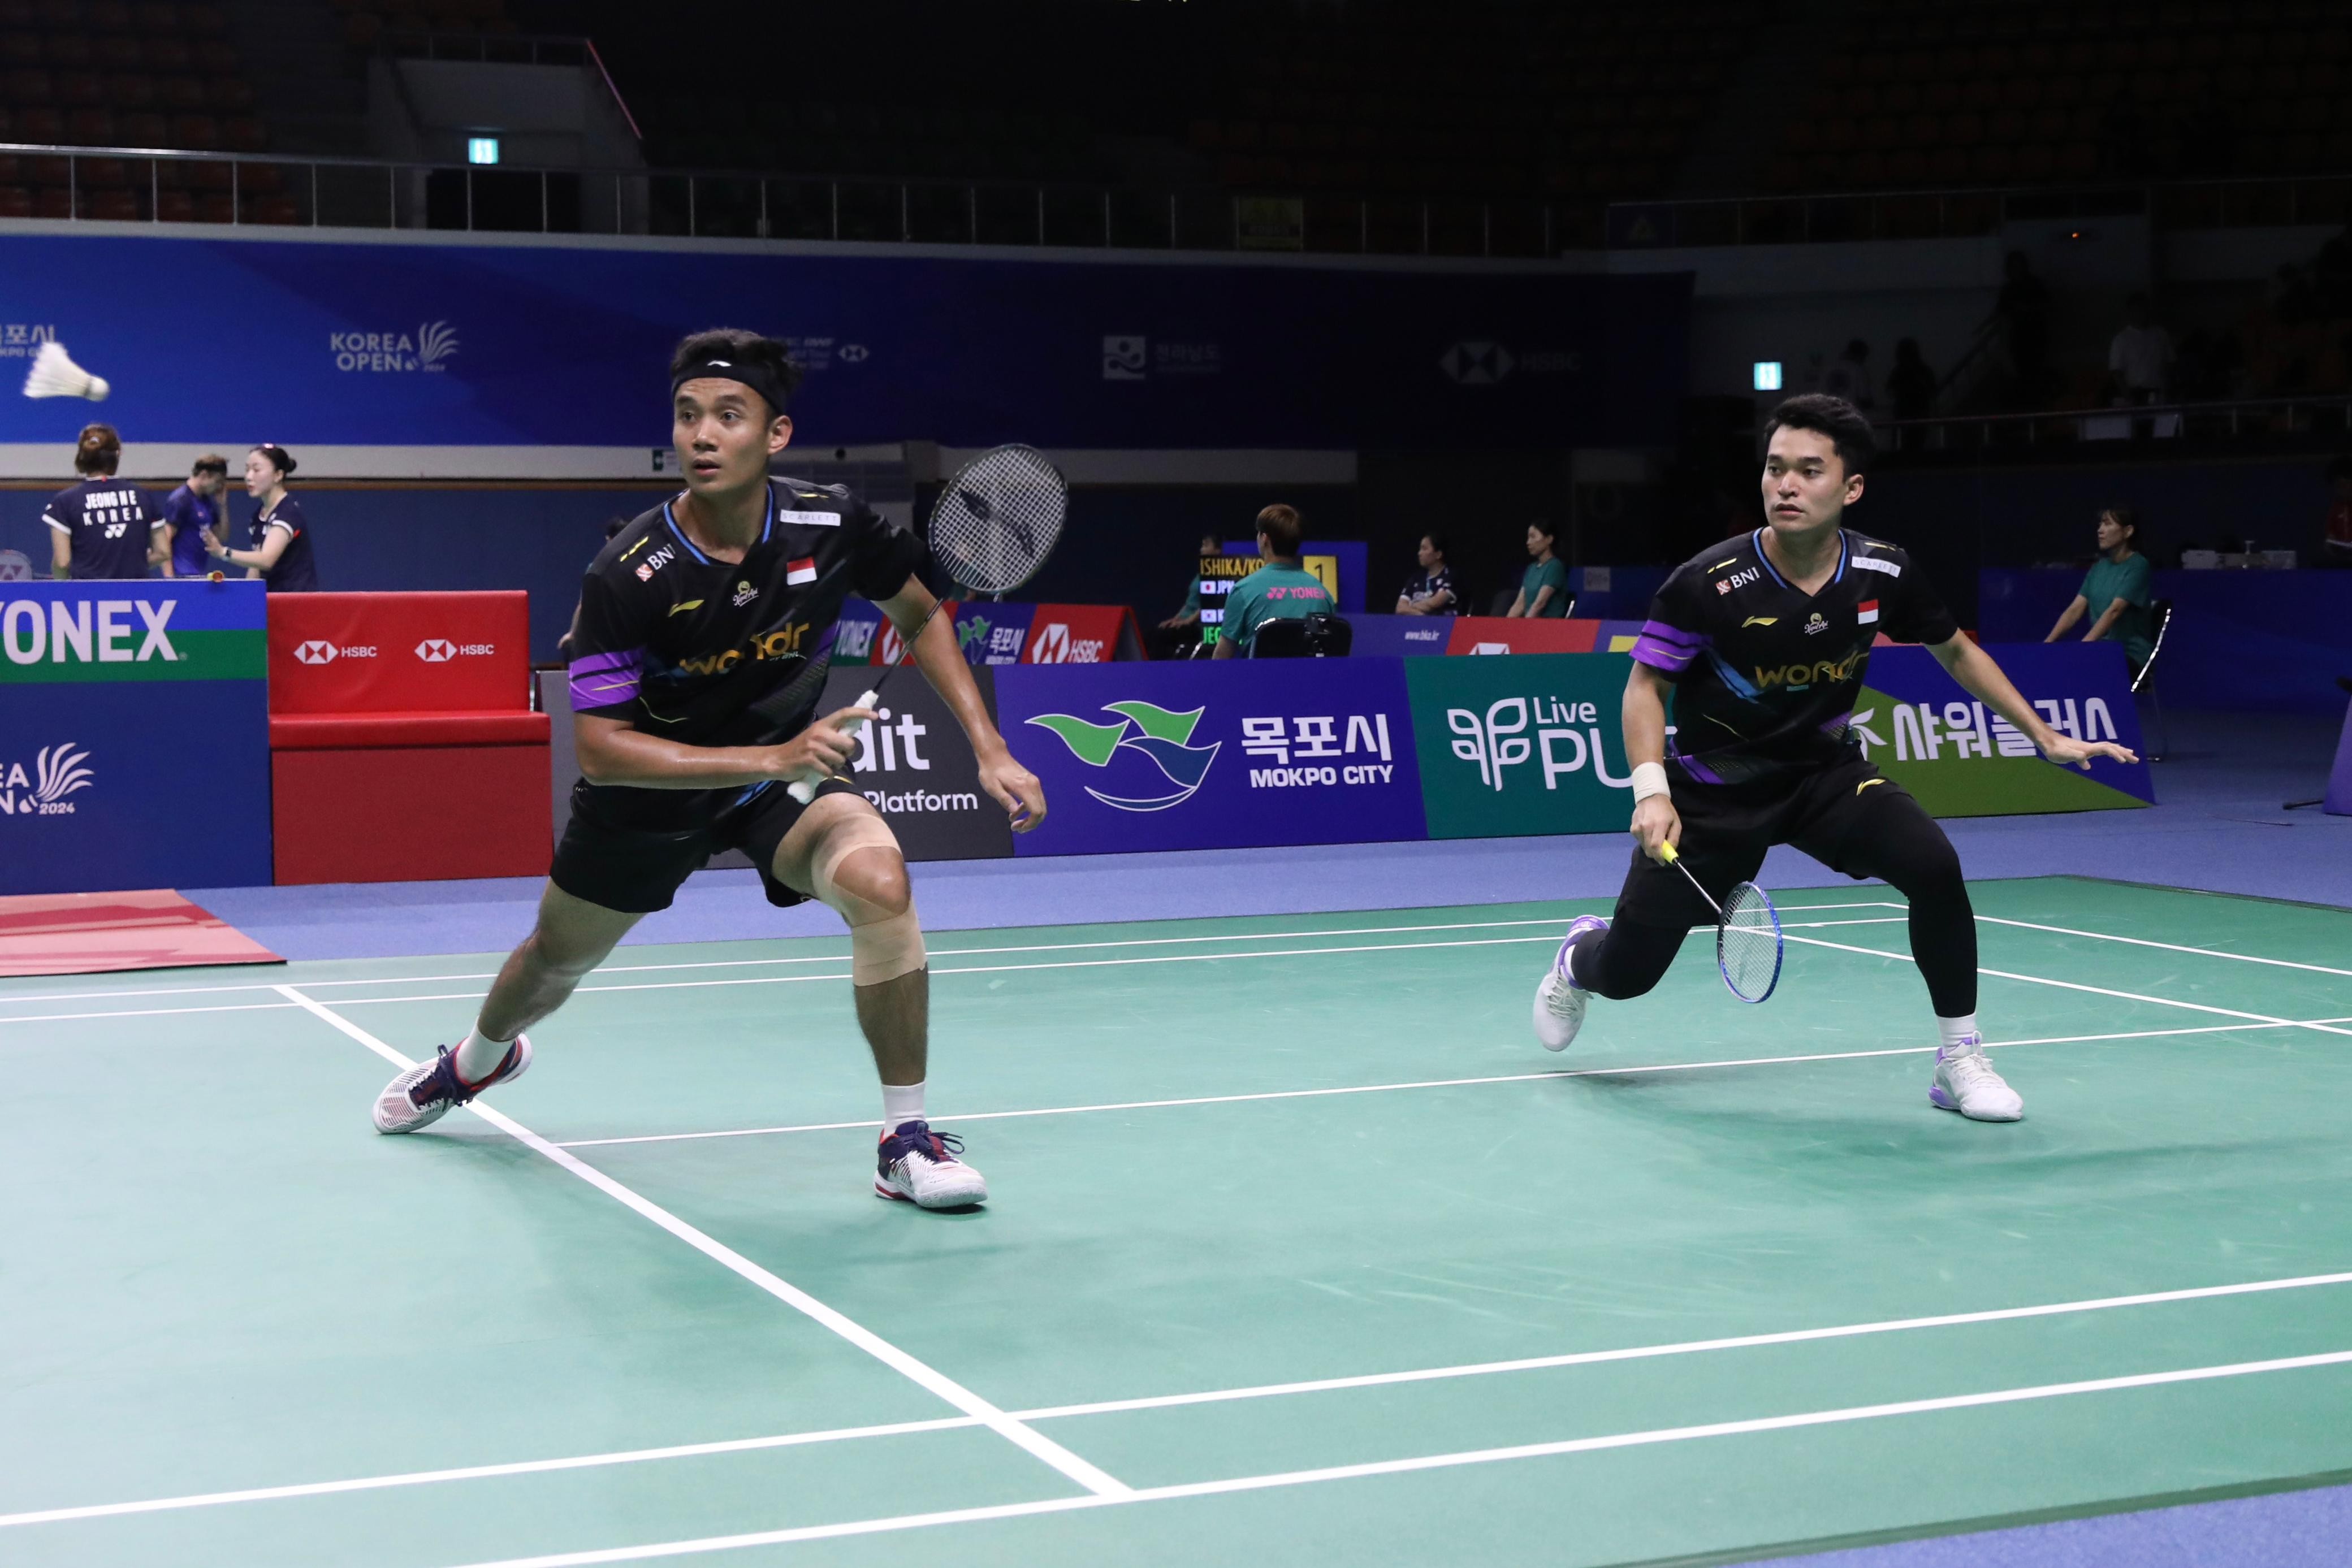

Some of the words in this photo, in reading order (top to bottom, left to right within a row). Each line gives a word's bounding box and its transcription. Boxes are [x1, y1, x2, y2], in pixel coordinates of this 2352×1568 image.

[0, 324, 55, 344] 포시
[331, 333, 413, 351] KOREA
[337, 353, 402, 371] OPEN
[85, 491, 119, 509] JEONG
[83, 506, 143, 526] KOREA
[647, 543, 676, 570] BNI
[1730, 566, 1760, 588] BNI
[0, 600, 179, 664] ONEX
[341, 646, 377, 657] HSBC
[460, 644, 494, 655] HSBC
[1068, 639, 1104, 663] HSBC
[1533, 696, 1597, 724] Live
[1242, 713, 1392, 764] 목포시
[1250, 766, 1337, 788] MOKPO
[1343, 765, 1393, 785] CITY
[39, 802, 75, 815] 2024
[863, 789, 978, 813] Platform
